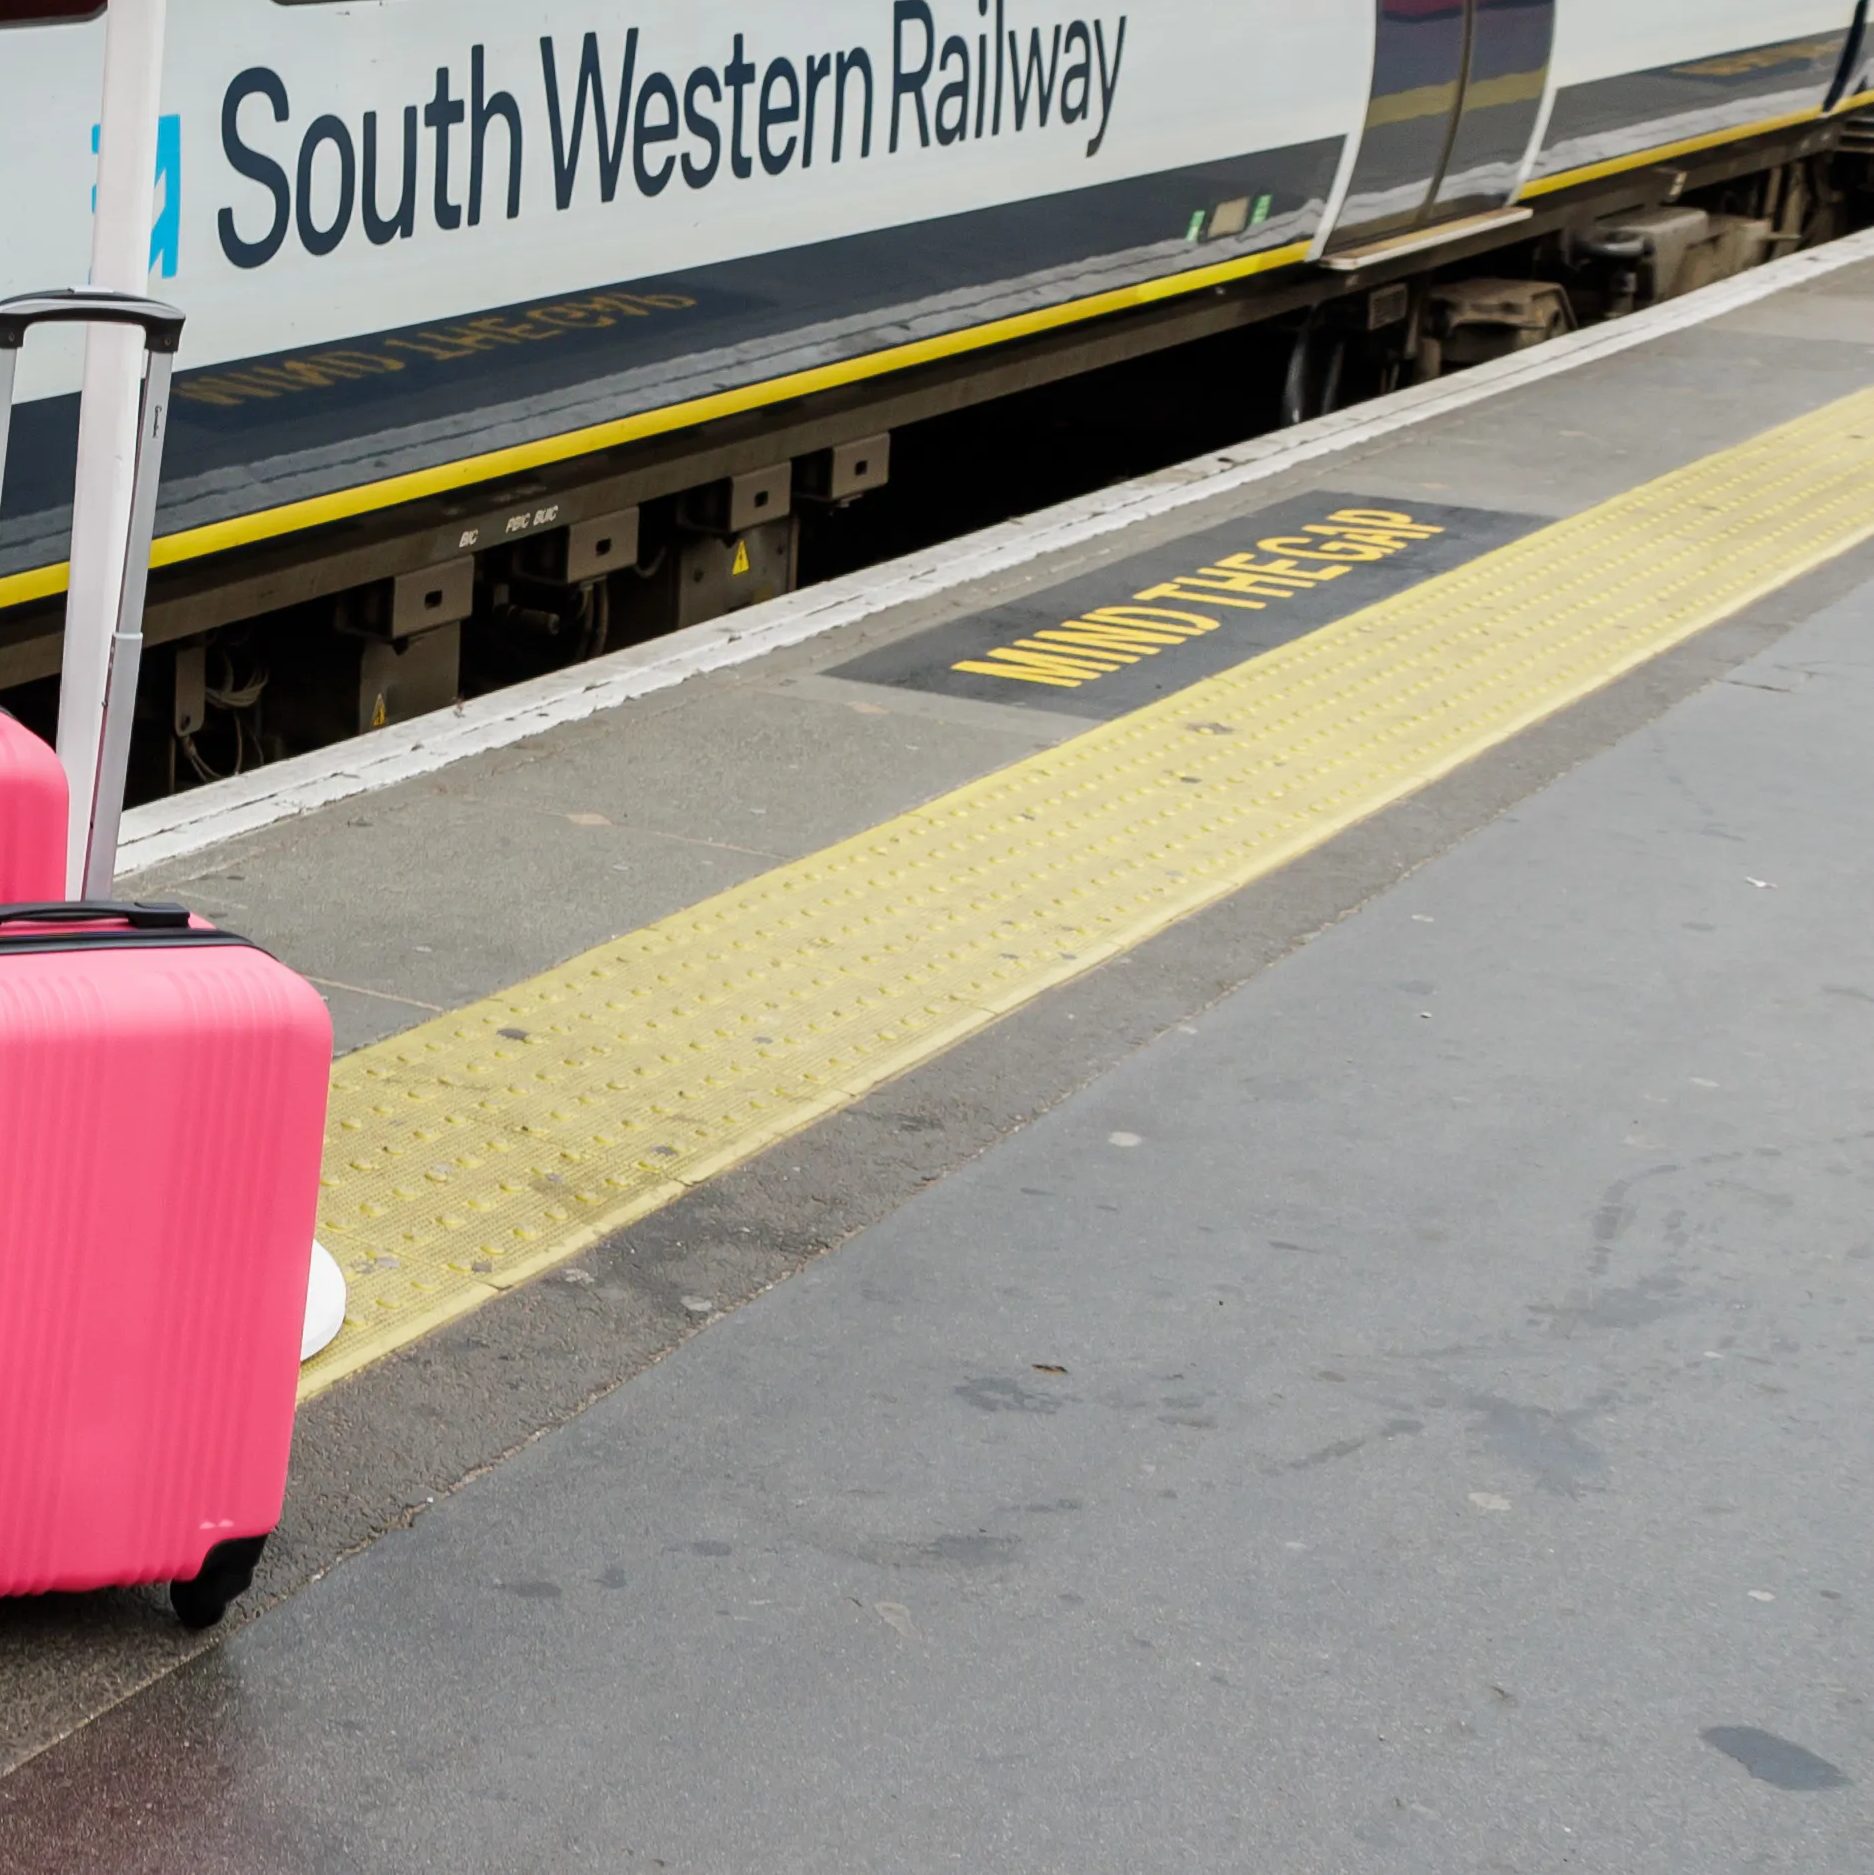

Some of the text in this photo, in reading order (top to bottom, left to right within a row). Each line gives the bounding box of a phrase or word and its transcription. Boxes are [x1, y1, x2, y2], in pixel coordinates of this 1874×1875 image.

[216, 42, 523, 271] South
[538, 25, 874, 211] Western
[951, 508, 1445, 688] MIND THE GAP
